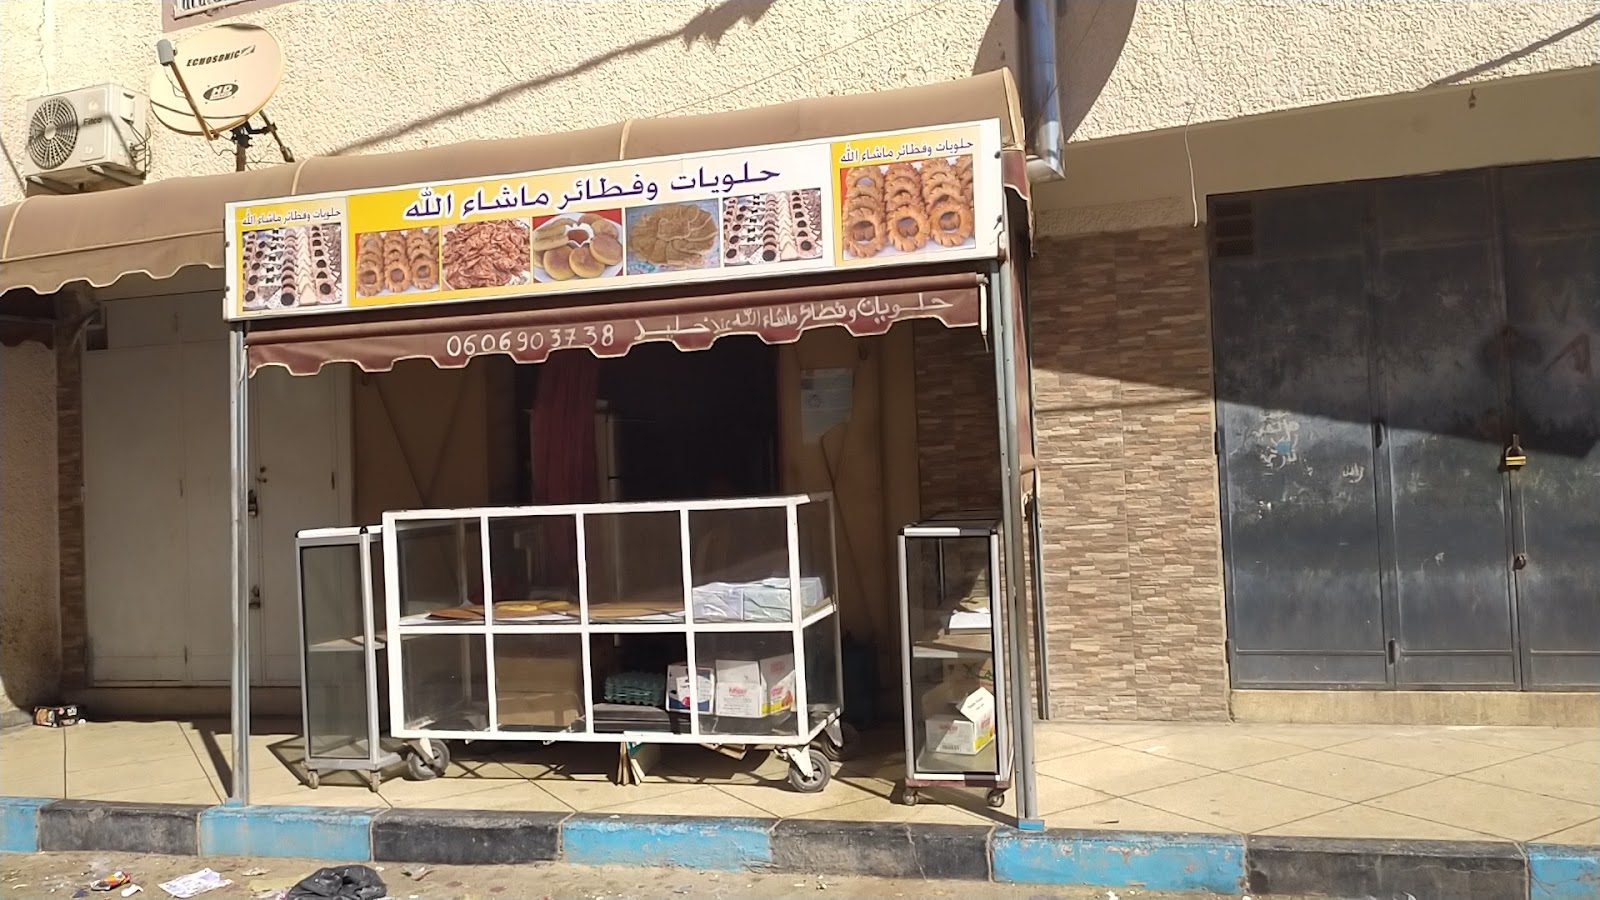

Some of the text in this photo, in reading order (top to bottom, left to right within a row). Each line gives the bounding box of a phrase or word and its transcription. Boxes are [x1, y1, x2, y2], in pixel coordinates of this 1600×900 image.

[186, 49, 240, 67] ECHOSONIC
[840, 138, 973, 162] حلويات وفطائر ماشاء الله
[406, 161, 780, 217] حلويات وفطائر ماشاء الله
[243, 212, 255, 225] الله
[258, 213, 281, 224] ماشاء
[313, 207, 341, 220] حلويات
[732, 307, 761, 327] الله
[763, 304, 798, 328] ماشاء
[857, 292, 953, 324] حلويات
